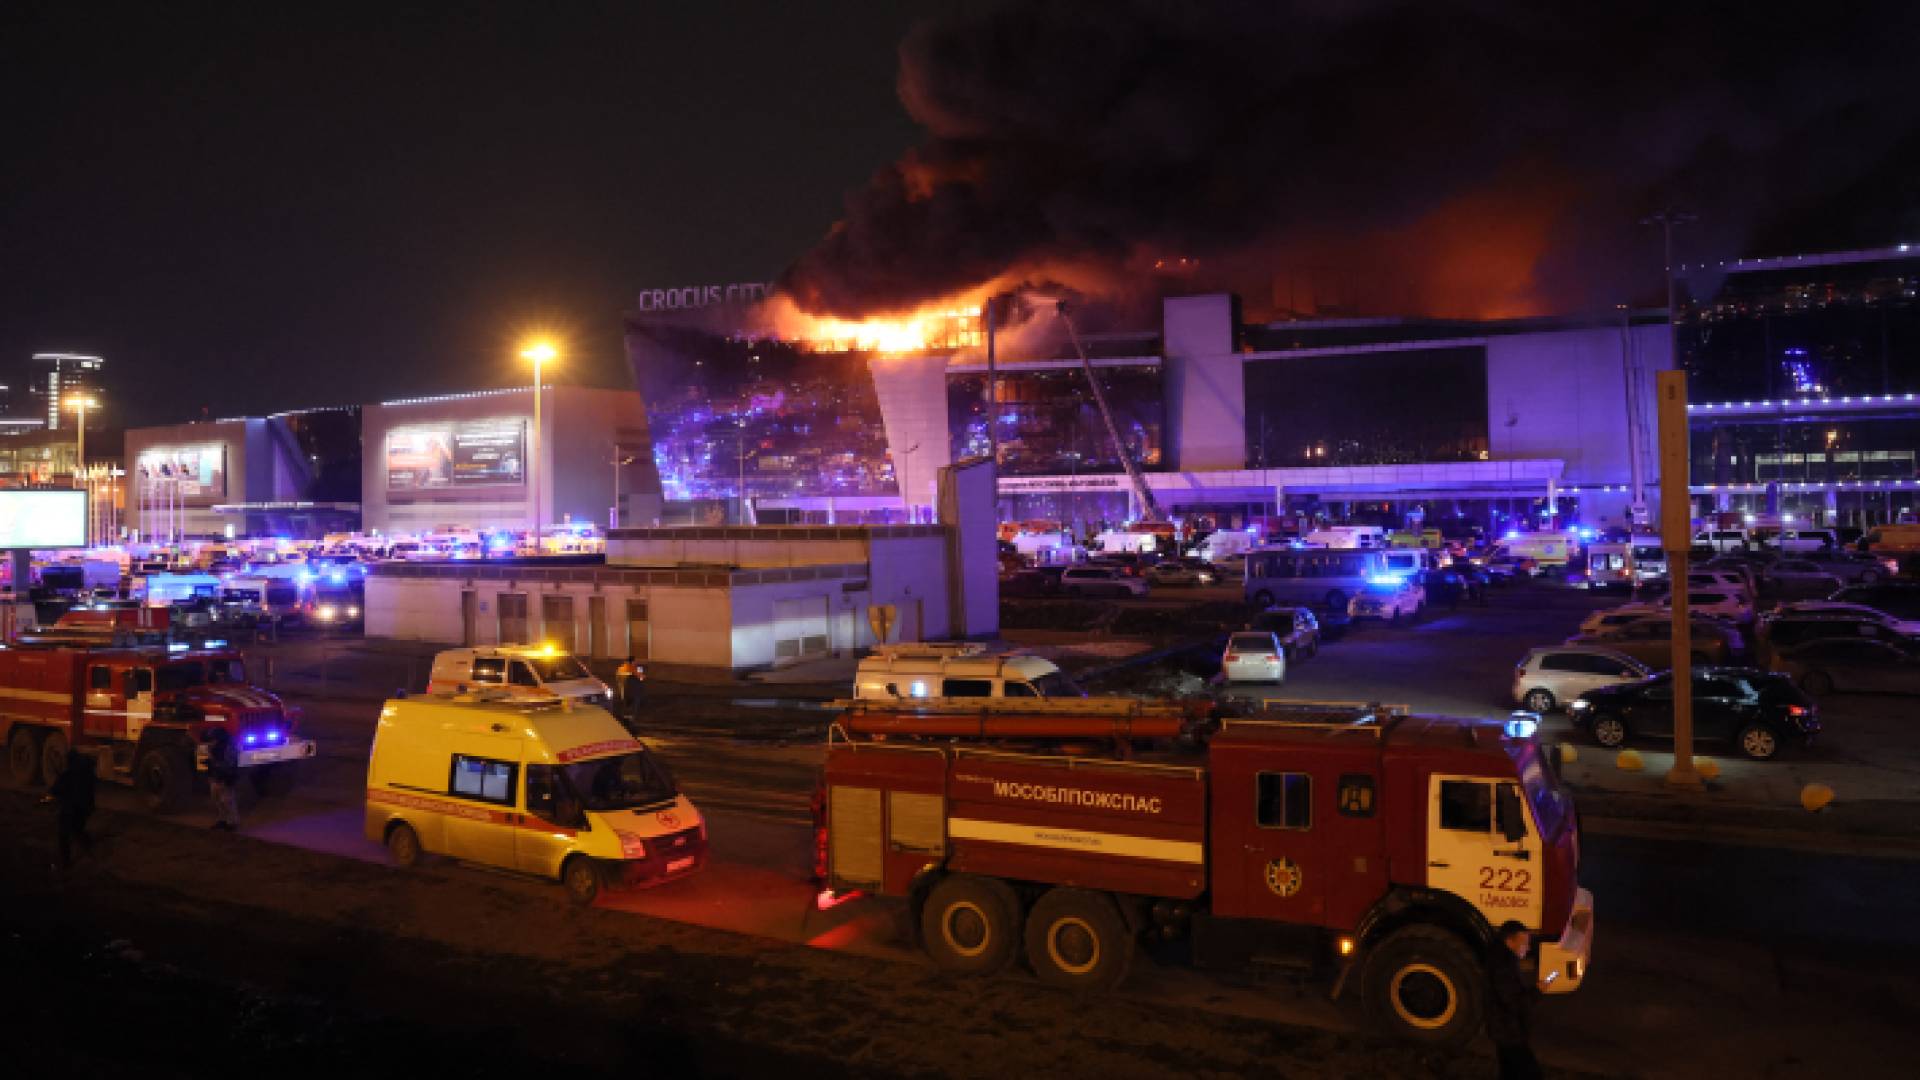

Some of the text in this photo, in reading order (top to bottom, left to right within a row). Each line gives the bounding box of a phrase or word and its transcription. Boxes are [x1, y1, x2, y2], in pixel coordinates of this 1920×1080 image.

[639, 284, 722, 312] CROCUS
[992, 780, 1163, 815] МОСОБЛПОЖСПАС
[1479, 866, 1532, 892] 222
